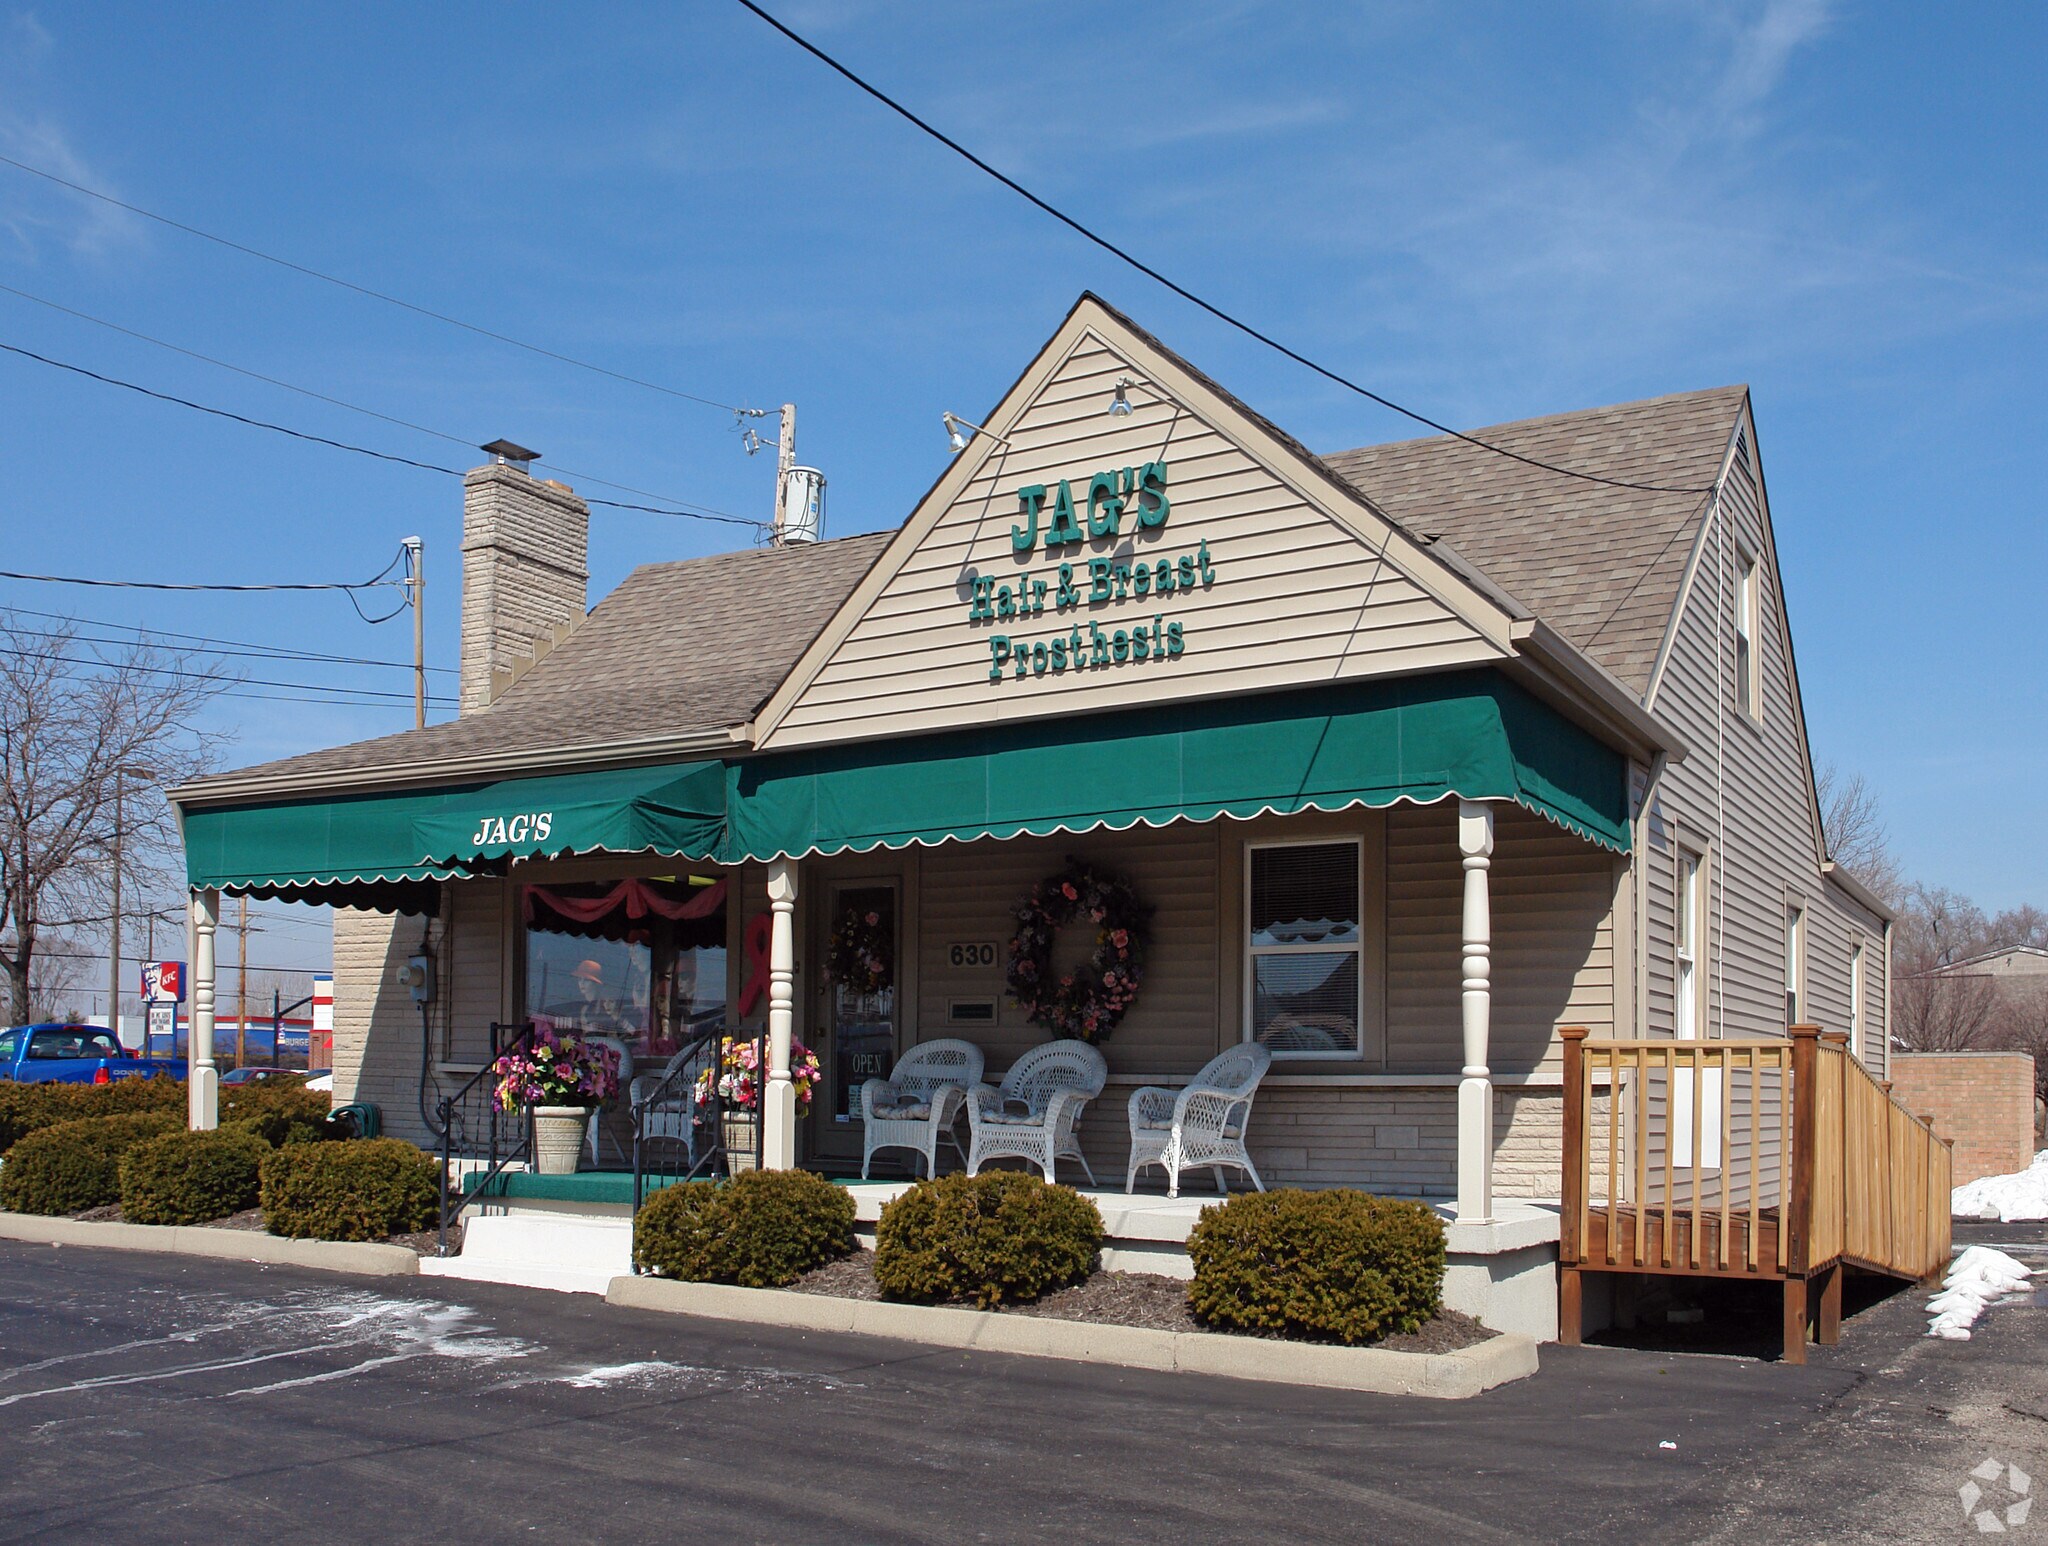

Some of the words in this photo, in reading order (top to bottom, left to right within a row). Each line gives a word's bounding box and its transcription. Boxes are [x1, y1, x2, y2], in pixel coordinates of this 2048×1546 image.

[1011, 460, 1171, 550] JAG'S
[969, 571, 1047, 620] Hair
[1056, 562, 1081, 607] &
[1088, 538, 1216, 602] Breast
[989, 613, 1185, 678] Prosthesis
[473, 812, 553, 846] JAG'S
[951, 944, 994, 966] 630
[162, 970, 177, 986] KFC
[285, 1038, 309, 1046] BURGE
[852, 1054, 881, 1073] OPEN
